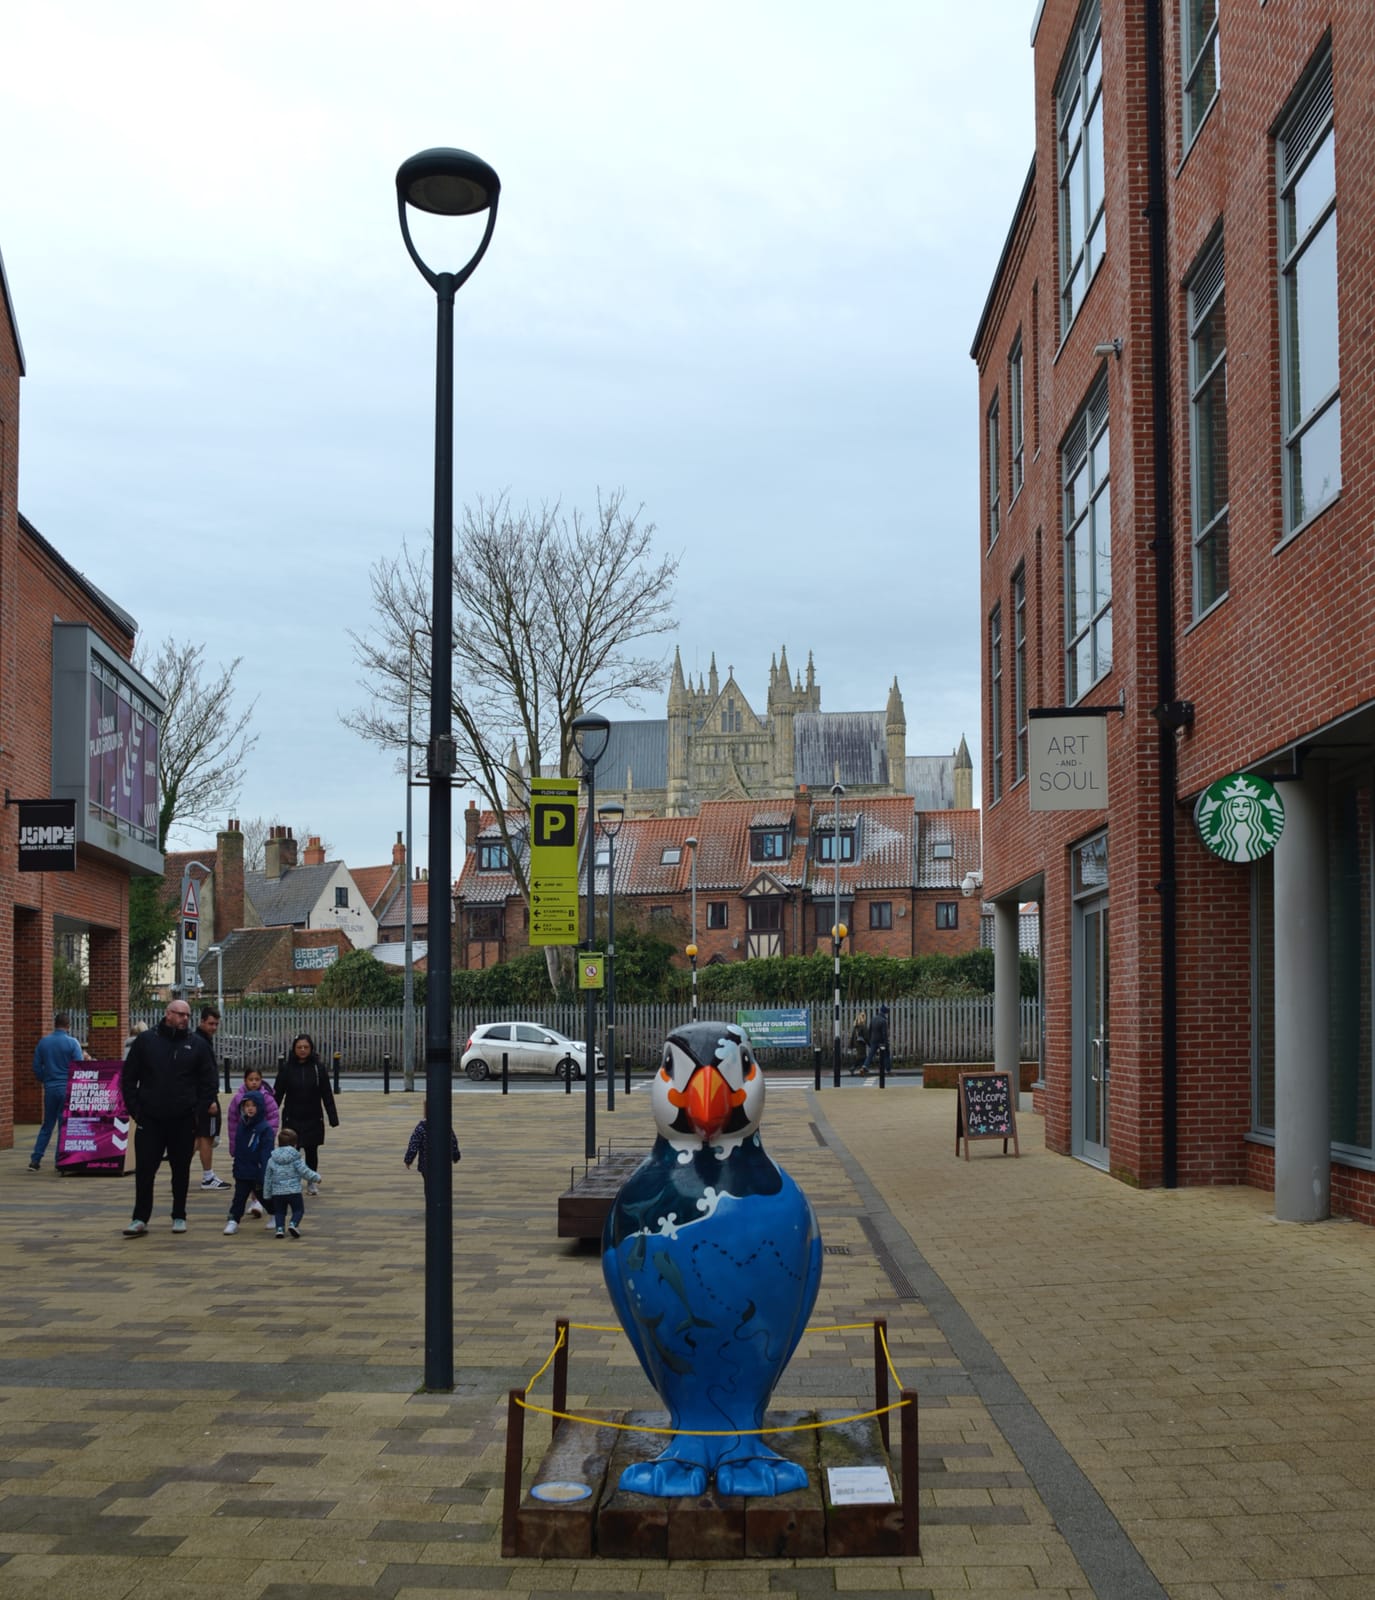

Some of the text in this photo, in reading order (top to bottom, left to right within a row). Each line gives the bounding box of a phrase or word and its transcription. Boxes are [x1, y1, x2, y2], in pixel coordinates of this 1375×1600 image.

[1047, 735, 1089, 755] ART
[1040, 771, 1099, 791] SOUL
[543, 810, 567, 840] P
[20, 826, 64, 845] JUMP
[295, 947, 319, 958] BEER
[295, 957, 337, 969] GARDEN
[70, 1089, 111, 1097] NEW PARK
[968, 1090, 1007, 1103] Welcome
[969, 1111, 982, 1125] Art
[988, 1110, 1009, 1124] Soul
